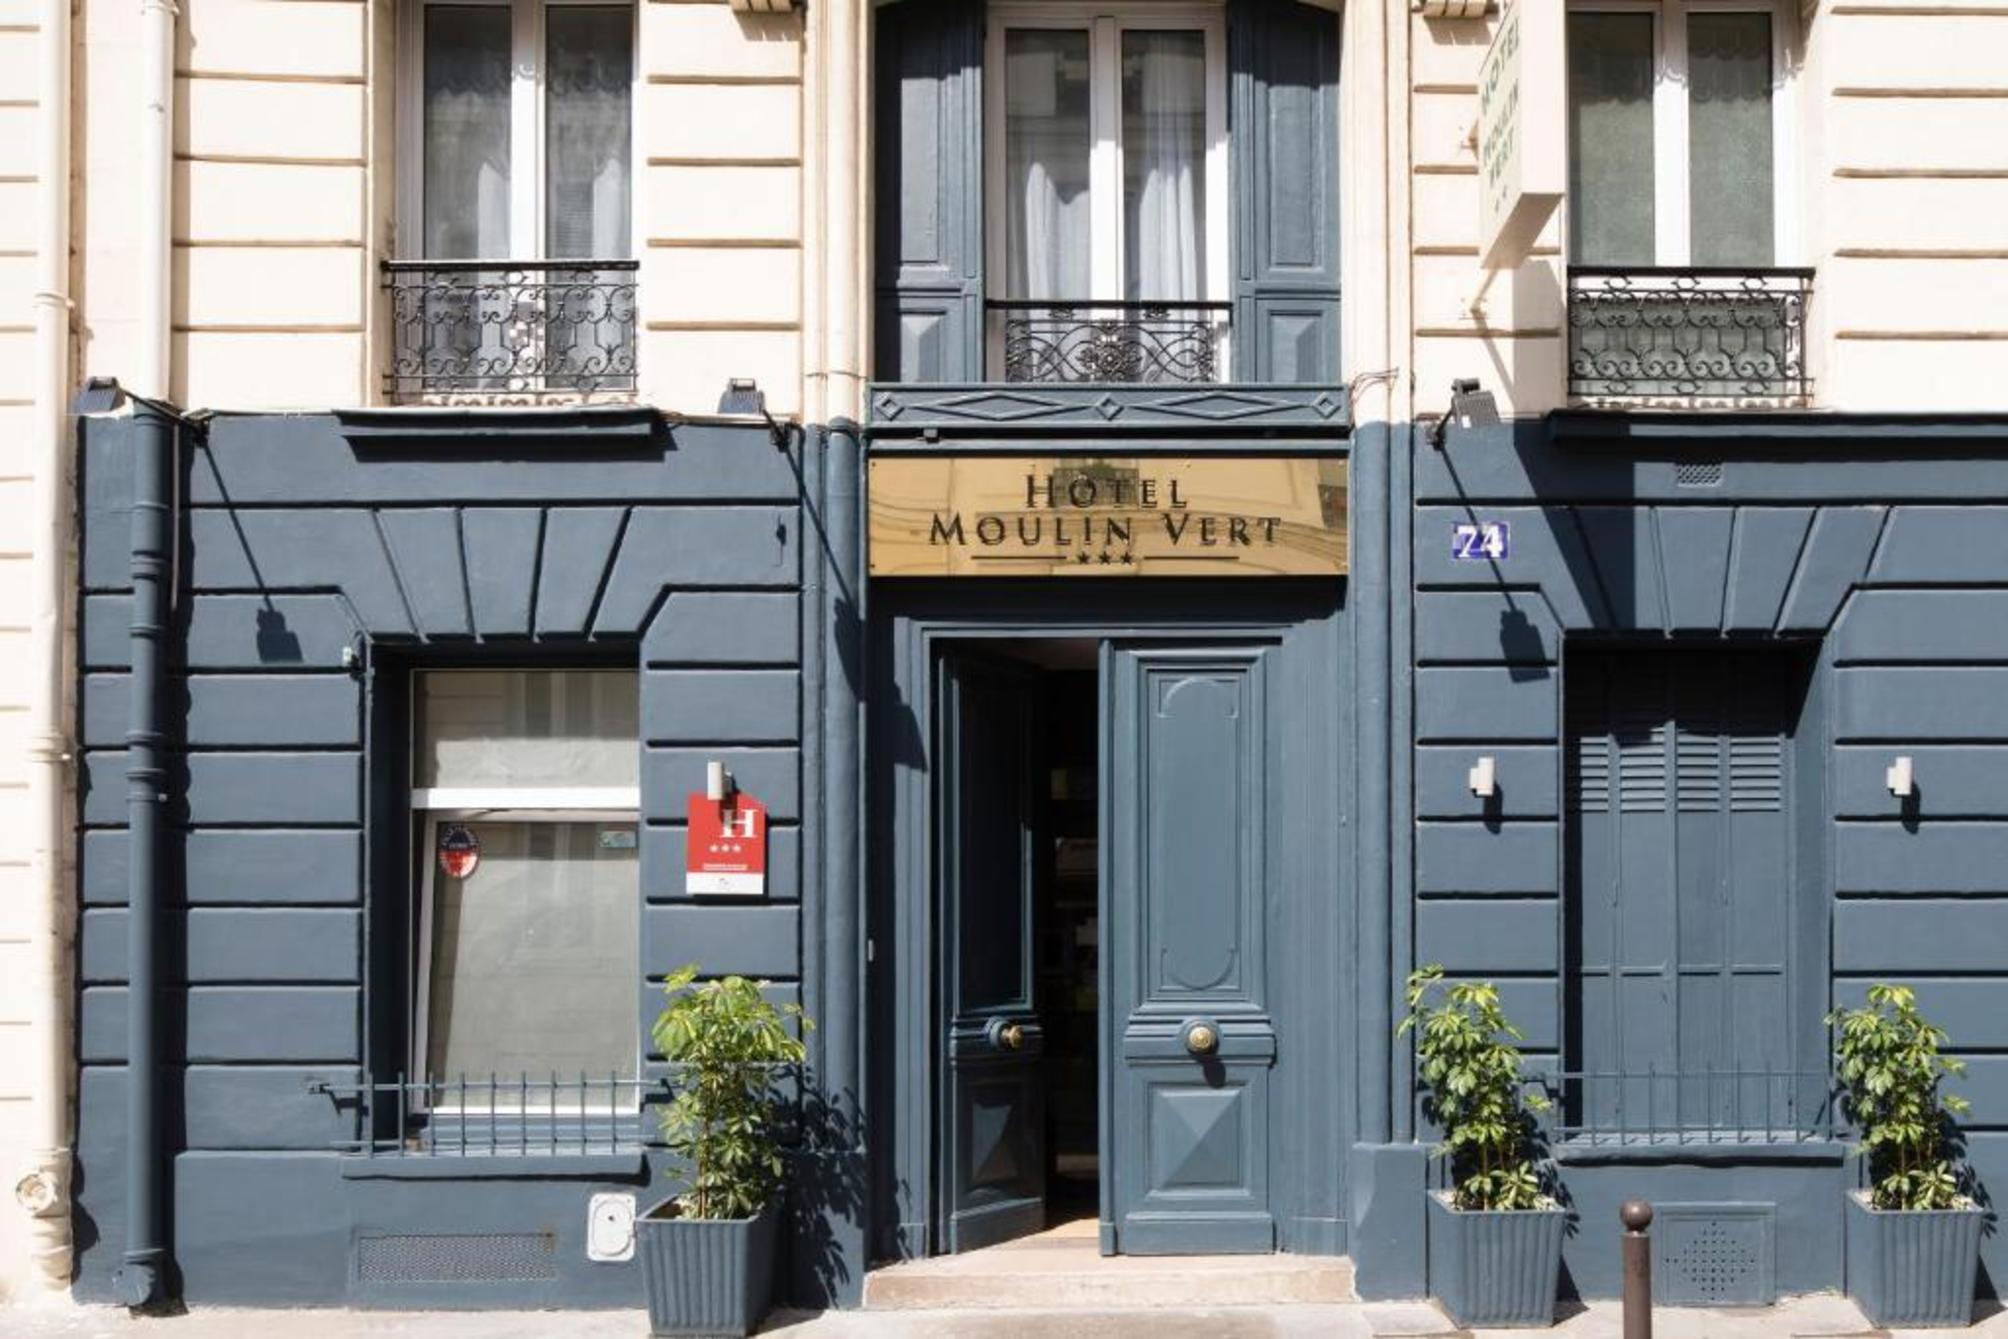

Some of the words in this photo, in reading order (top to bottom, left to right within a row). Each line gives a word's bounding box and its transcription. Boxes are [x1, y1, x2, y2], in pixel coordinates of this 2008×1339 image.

[929, 512, 1132, 546] MOULIN
[1162, 512, 1282, 546] VERT
[1458, 525, 1503, 557] 74
[720, 808, 759, 839] H
